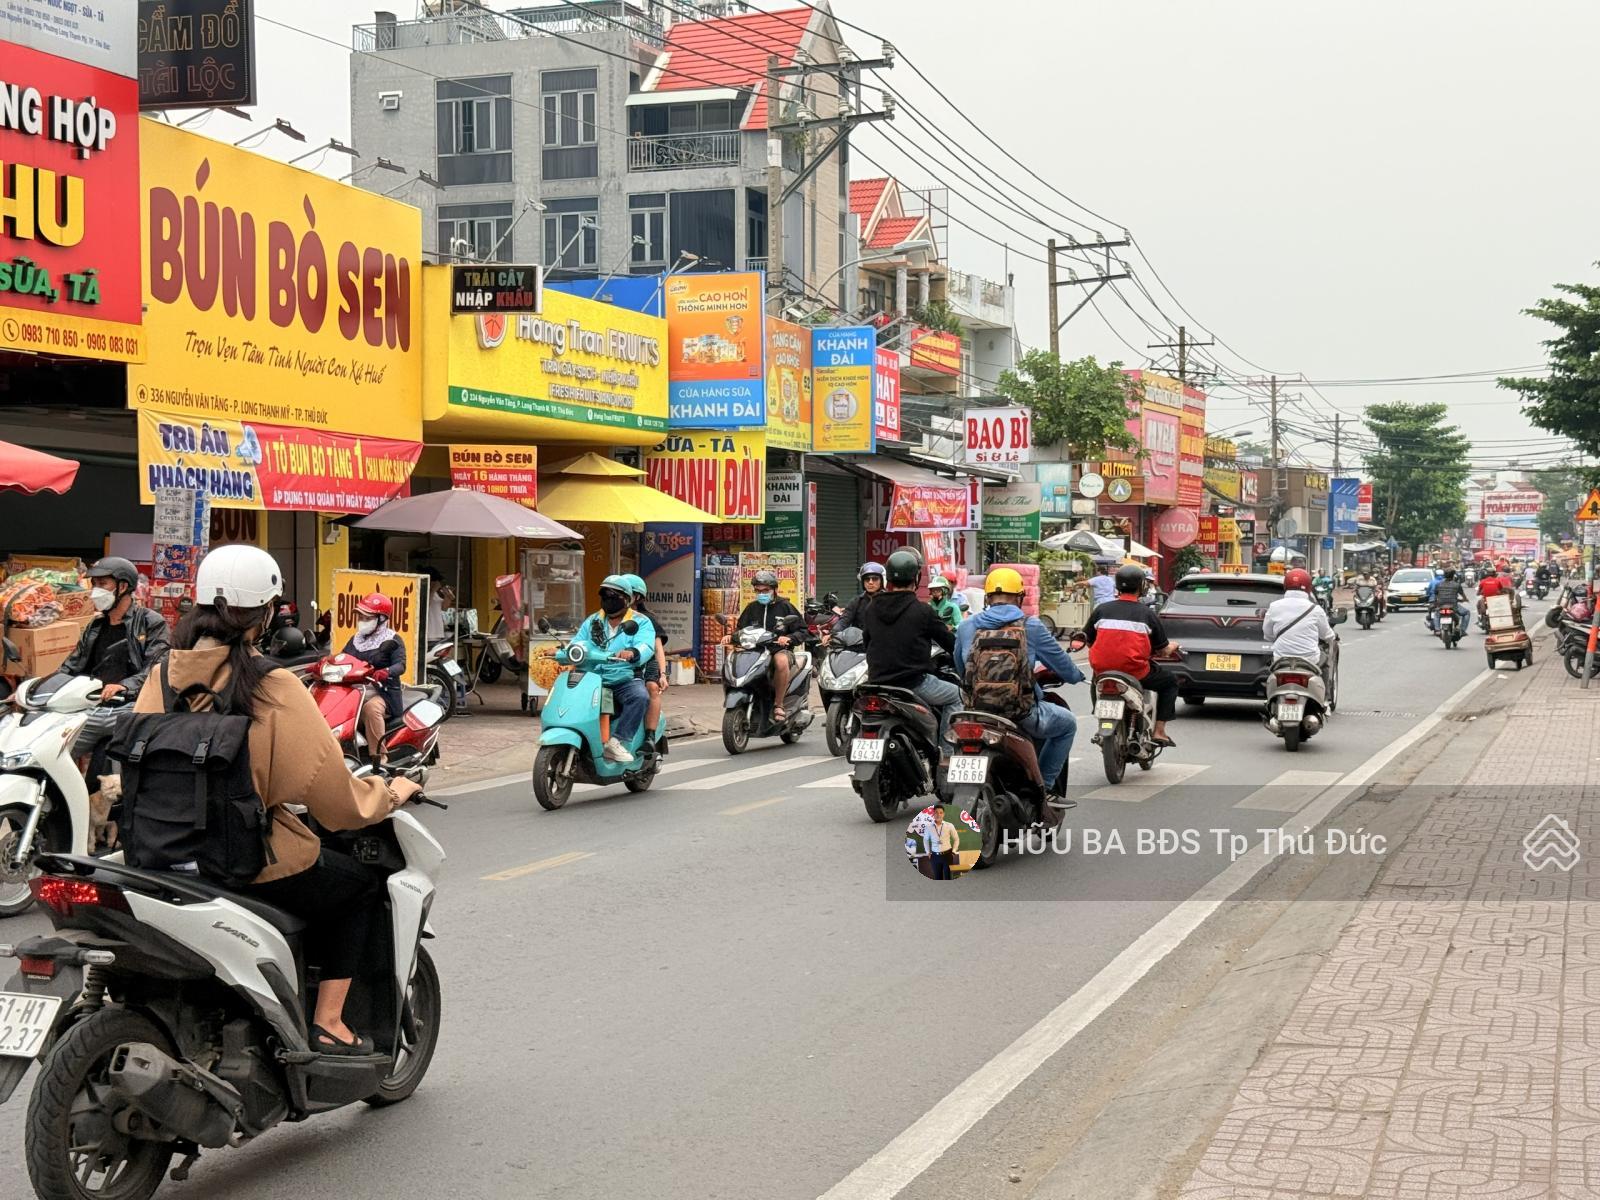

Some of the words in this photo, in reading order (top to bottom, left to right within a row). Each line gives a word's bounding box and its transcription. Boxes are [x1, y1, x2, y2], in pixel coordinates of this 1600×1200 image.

[187, 57, 235, 97] LỘC
[53, 96, 117, 160] HỢP
[150, 156, 256, 322] BÚN
[268, 193, 328, 334] BÒ
[337, 240, 411, 353] SEN
[464, 268, 495, 287] TRÁI
[498, 266, 525, 287] CÂY
[455, 289, 493, 310] NHẬP
[496, 286, 533, 307] KHẨU
[699, 292, 722, 303] CAO
[724, 288, 748, 301] HƠN
[678, 303, 705, 312] THÔNG
[706, 302, 728, 311] MINH
[730, 301, 748, 310] HƠN
[21, 323, 43, 342] 0983
[45, 327, 60, 345] 710
[62, 329, 78, 348] 850
[86, 333, 106, 351] 0903
[109, 336, 123, 353] 083
[125, 338, 138, 355] 031
[607, 328, 660, 367] FRUITS
[817, 338, 868, 351] KHANH
[186, 330, 213, 358] Trọn
[217, 336, 238, 363] Vẹn
[242, 340, 265, 365] Tâm
[269, 345, 292, 369] Tình
[294, 349, 327, 377] Người
[327, 357, 347, 378] Con
[349, 358, 364, 385] Xứ
[364, 363, 387, 384] Huế
[830, 350, 854, 365] ĐÀI
[678, 387, 699, 399] CỬA
[700, 387, 727, 397] HÀNG
[728, 385, 751, 397] SỮA
[150, 387, 164, 403] 336
[165, 387, 194, 408] NGUYỄN
[195, 392, 210, 410] VĂN
[211, 394, 229, 412] TĂNG
[233, 399, 240, 414] P.
[241, 400, 258, 416] LONG
[259, 403, 280, 419] THẠNH
[280, 404, 290, 420] MỸ
[295, 408, 304, 421] TP.
[304, 406, 316, 423] THỦ
[316, 408, 328, 424] ĐỨC
[669, 404, 728, 419] KHANH
[732, 398, 760, 417] ĐÀI
[159, 423, 196, 452] TRI
[200, 422, 229, 454] ÂN
[967, 416, 1005, 449] BAO
[1009, 410, 1029, 449] BÌ
[653, 435, 694, 453] SỮA
[710, 434, 736, 453] TÃ
[265, 441, 272, 472] 1
[273, 434, 288, 474] TÔ
[289, 434, 311, 475] BÚN
[311, 437, 326, 477] BÒ
[326, 440, 353, 487] TẶNG
[354, 438, 364, 480] 1
[452, 449, 480, 462] BÚN
[483, 450, 503, 463] BÒ
[505, 453, 533, 464] SEN
[991, 452, 1002, 462] &
[149, 457, 206, 492] KHÁCH
[210, 461, 253, 498] HÀNG
[454, 471, 471, 480] NGÀY
[472, 470, 488, 481] 16
[488, 472, 507, 481] HÀNG
[509, 473, 533, 482] THÁNG
[724, 445, 760, 517] ĐÀI
[766, 482, 800, 491] KHANH
[273, 486, 283, 504] ÁP
[284, 491, 303, 509] DỤNG
[773, 492, 791, 503] ĐÀI
[1161, 523, 1194, 533] MYRA
[658, 532, 693, 551] Tiger
[676, 590, 692, 603] ĐÀI
[852, 750, 880, 761] 494.34
[955, 758, 982, 770] 49-E1
[950, 770, 983, 782] 516.66
[400, 879, 422, 894] HONDA
